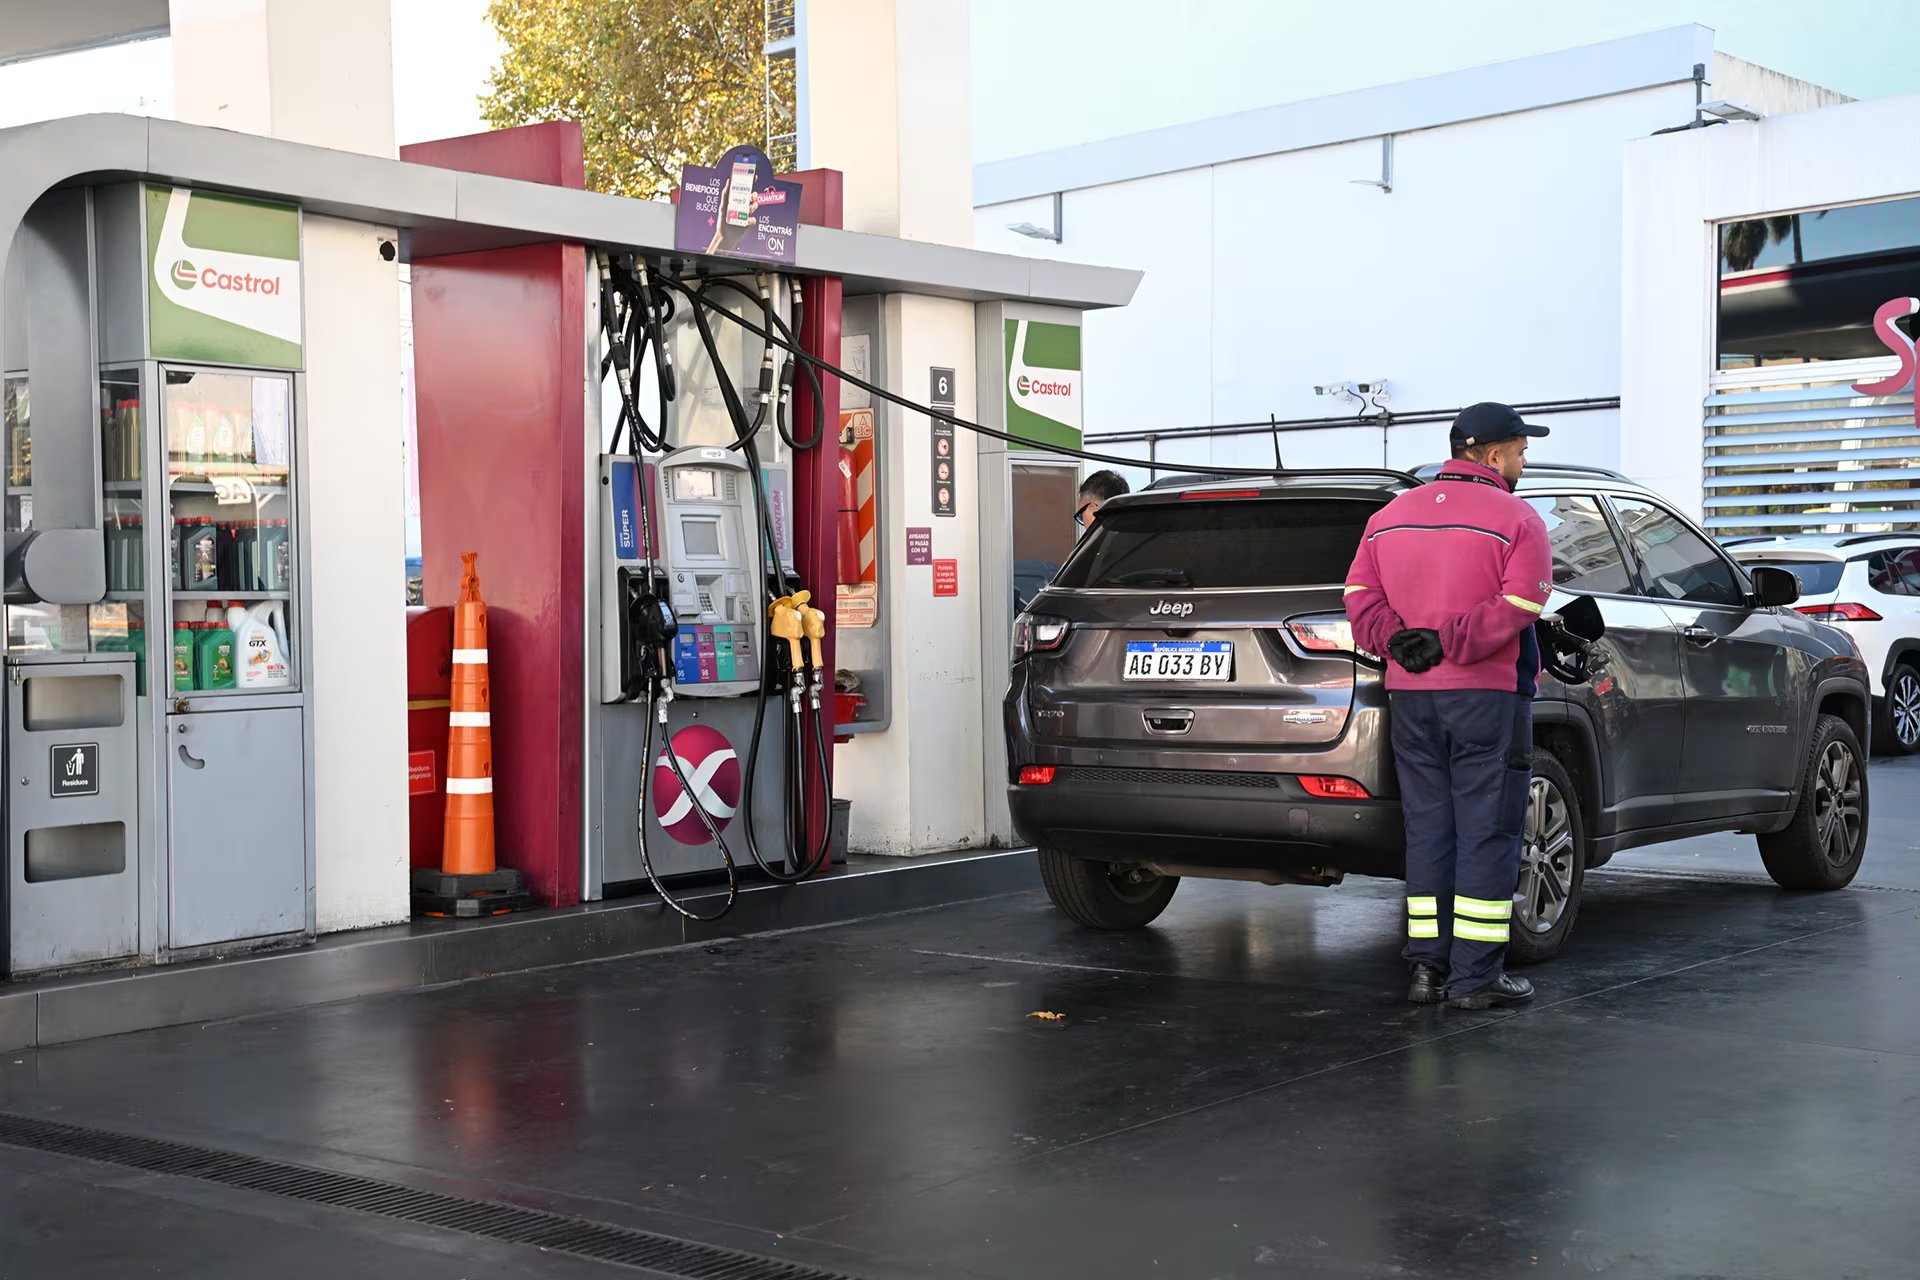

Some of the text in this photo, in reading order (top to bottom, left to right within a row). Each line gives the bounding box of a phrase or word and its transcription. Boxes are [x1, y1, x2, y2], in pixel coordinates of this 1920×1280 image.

[685, 183, 719, 195] BENEFICIOS
[710, 178, 720, 187] LOS
[706, 195, 719, 205] QUE
[757, 194, 785, 203] QUANTIUM
[759, 216, 770, 224] LOS
[758, 224, 792, 236] ENCONTRÁS
[768, 237, 784, 251] ON
[201, 268, 280, 295] Castrol
[1851, 296, 1920, 429] S
[938, 376, 948, 395] 6
[1031, 380, 1071, 396] Castrol
[773, 489, 784, 550] QUANTIUM
[621, 509, 631, 548] SUPER
[1149, 600, 1194, 618] Jeep
[1129, 654, 1225, 675] AG 033 BY
[702, 669, 709, 677] 98
[62, 779, 88, 787] Residuos
